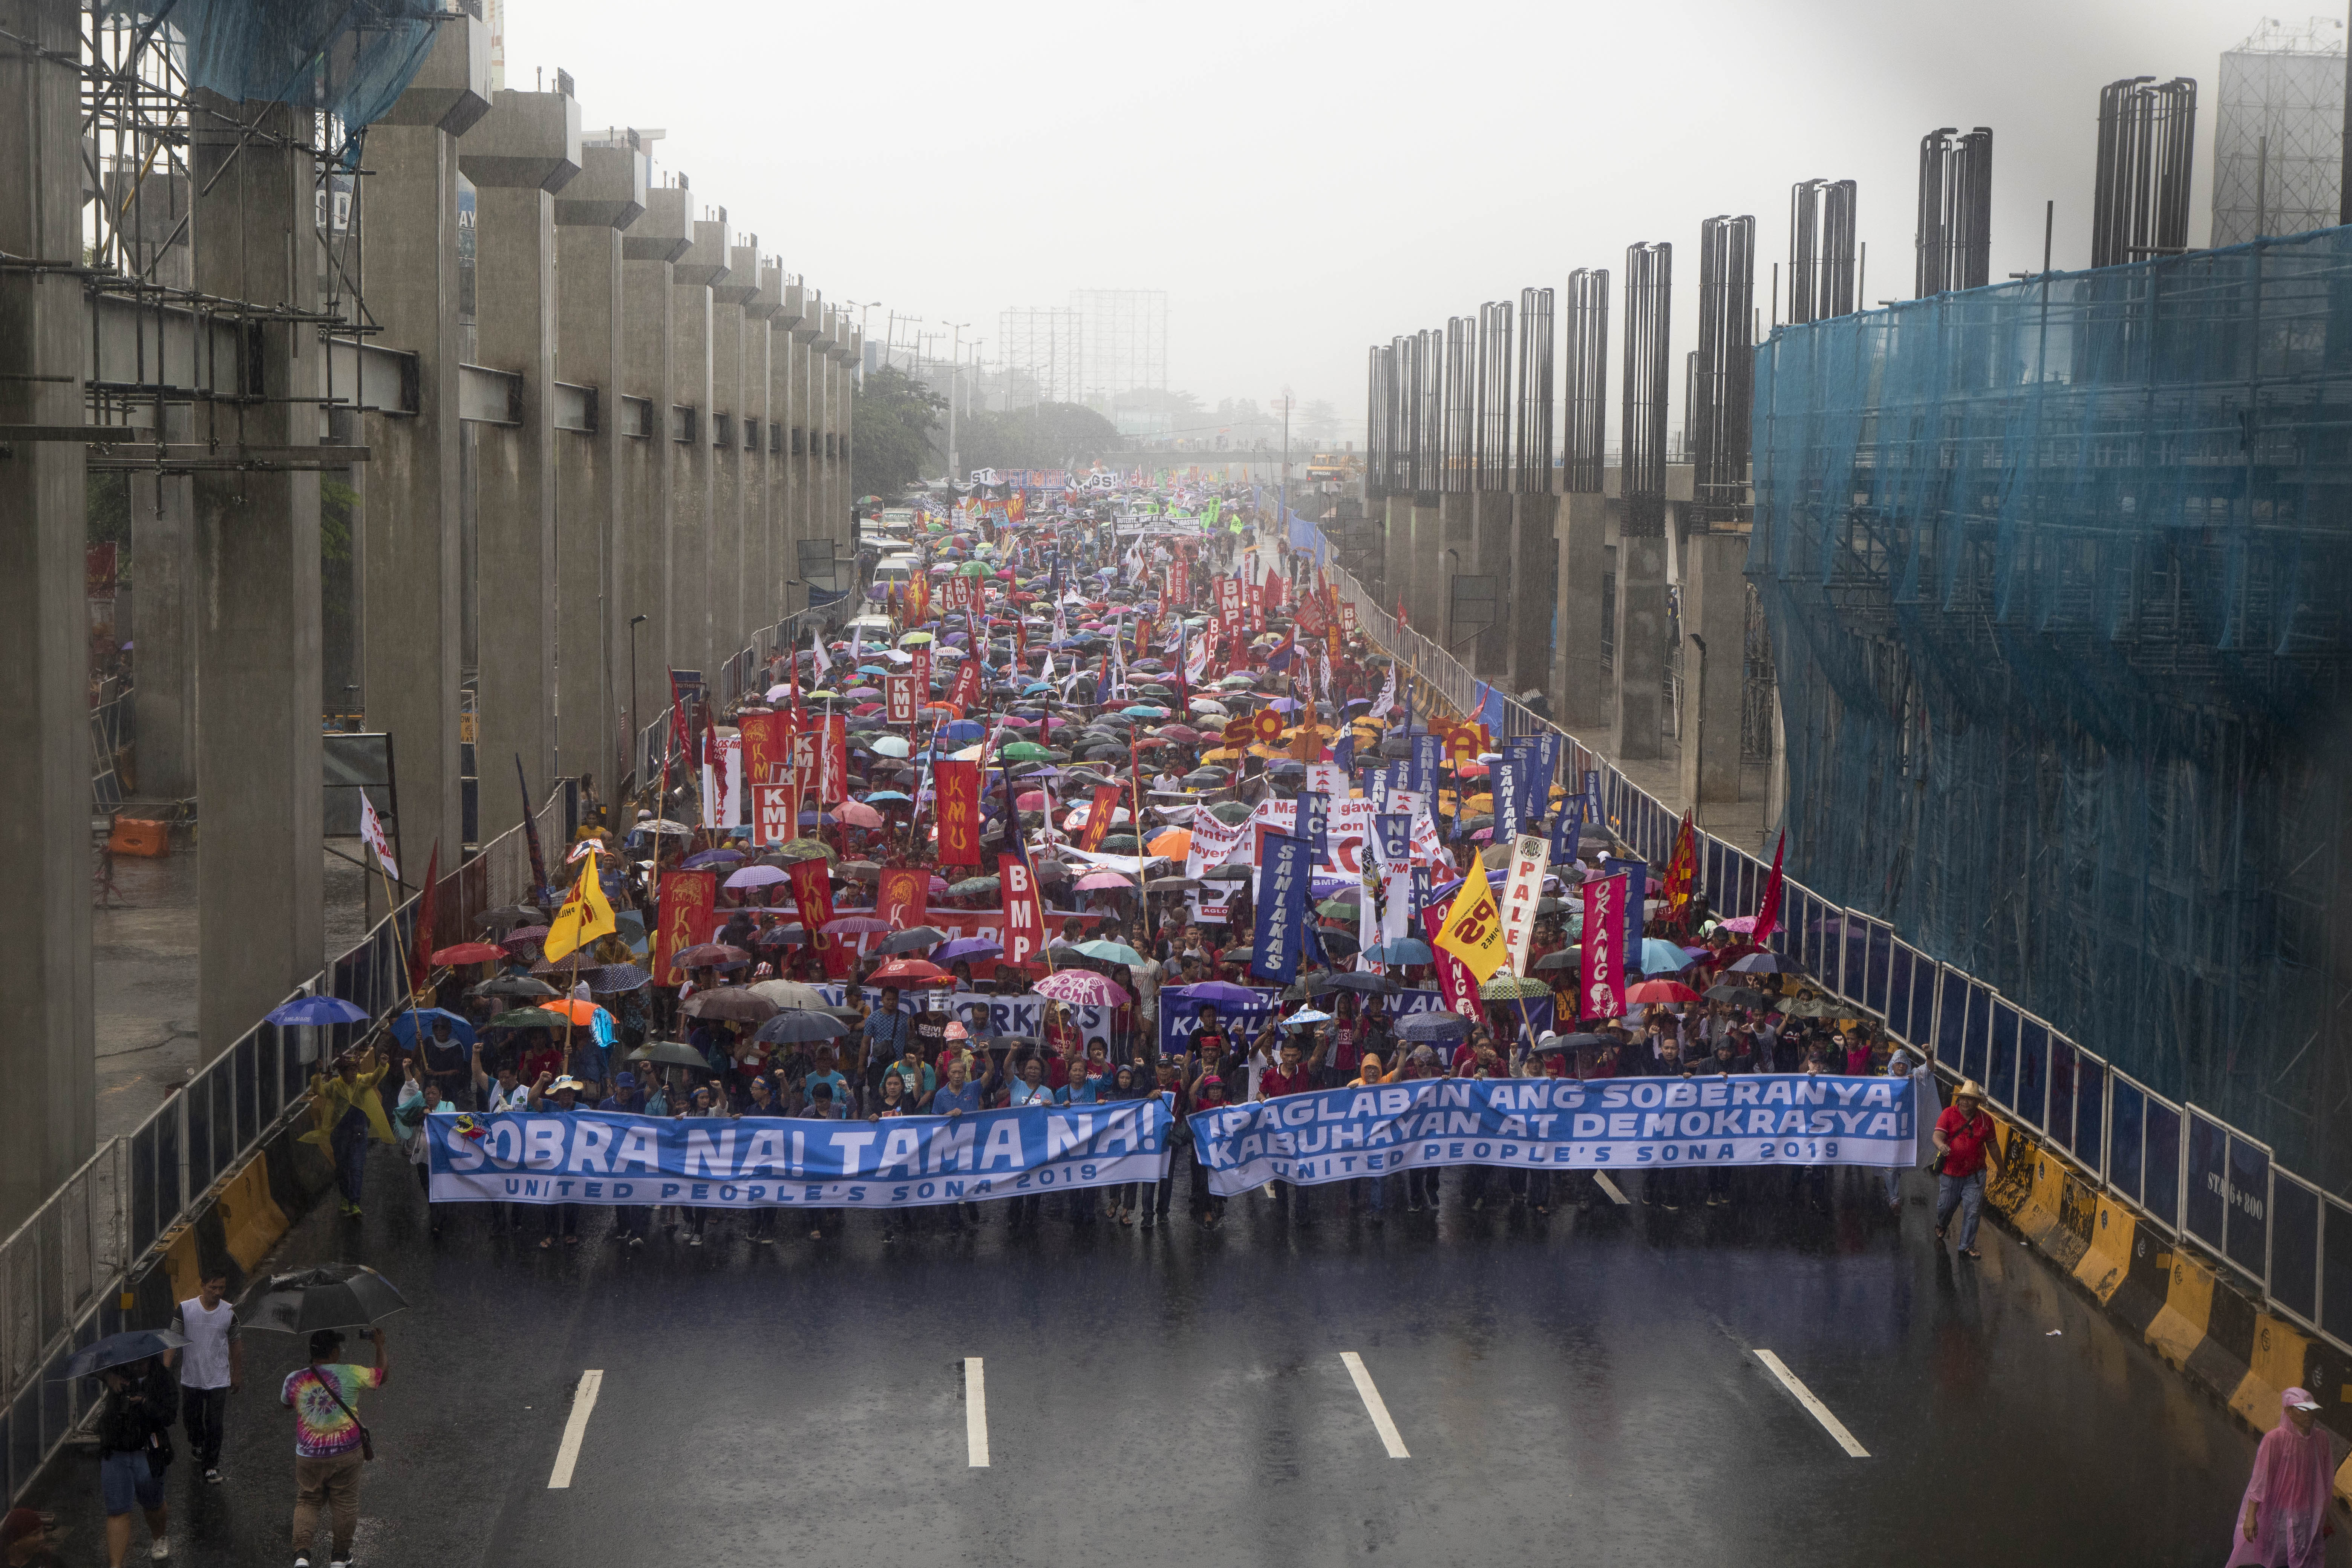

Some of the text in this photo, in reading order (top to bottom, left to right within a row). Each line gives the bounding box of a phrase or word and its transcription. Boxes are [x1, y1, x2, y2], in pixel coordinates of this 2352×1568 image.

[1026, 469, 1066, 486] DTERTE
[955, 579, 966, 603] KMU
[1222, 580, 1239, 625] BMP
[1207, 619, 1219, 662] BMP
[1329, 626, 1338, 655] BMP
[1344, 608, 1354, 642] BMP
[916, 655, 926, 694] DFA
[954, 666, 973, 706] DFA
[893, 679, 910, 718] KMU
[730, 740, 741, 749] NA
[763, 789, 786, 841] KMU
[944, 775, 966, 851] KMU
[1500, 765, 1517, 844] SANLAKA
[1387, 820, 1405, 856] NC
[1560, 799, 1581, 854] NCL
[802, 871, 830, 951] KMU
[1009, 865, 1031, 963] BMP
[1265, 845, 1296, 970] SANLAKAS
[1502, 861, 1535, 969] PALEA
[1021, 1096, 1041, 1105] SOP
[1208, 1081, 1902, 1138] IPAGLABAN ANG SOBERANYA,
[683, 1129, 805, 1178] NA!
[829, 1118, 1024, 1178] TAMA
[1047, 1102, 1156, 1161] NA!
[1207, 1107, 1908, 1169] KABUHAYAN AT DEMOKRASYA!
[1272, 1141, 1839, 1180] UNITED PEOPLE'S SONA 2019
[505, 1164, 1097, 1202] UNITED PEOPLE'S SONA 2019
